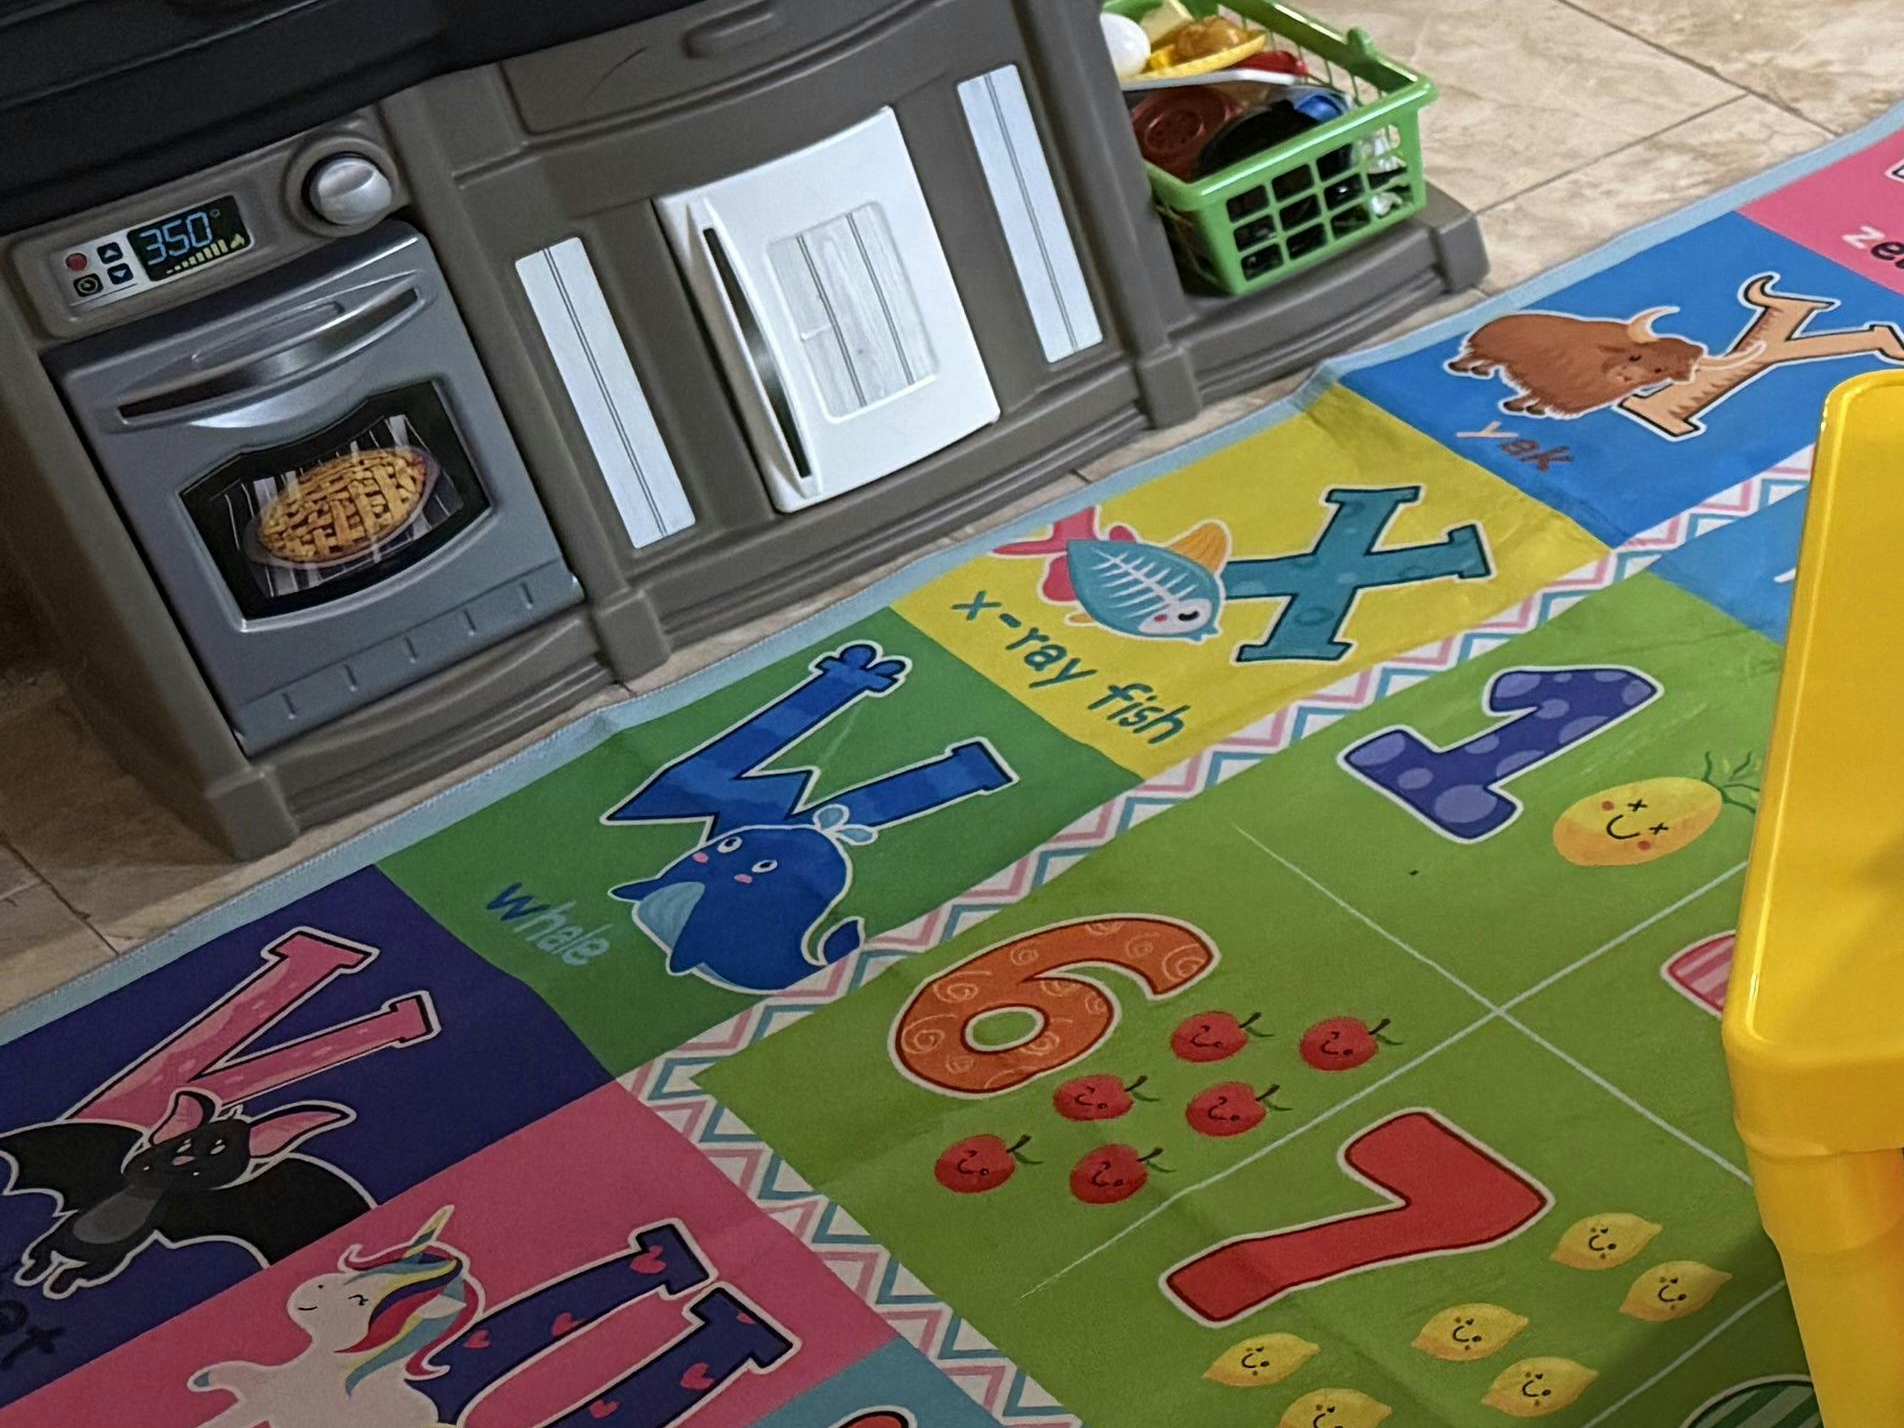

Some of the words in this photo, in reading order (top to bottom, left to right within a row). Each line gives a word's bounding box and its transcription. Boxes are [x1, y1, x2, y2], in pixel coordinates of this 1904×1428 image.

[1456, 419, 1575, 474] yak
[1224, 482, 1494, 666] X
[951, 587, 1095, 690] x-ray
[1085, 675, 1188, 748] fish
[1337, 665, 1665, 843] 1
[486, 882, 613, 966] whale
[890, 913, 1222, 1098] 6
[1159, 1107, 1556, 1328] 7
